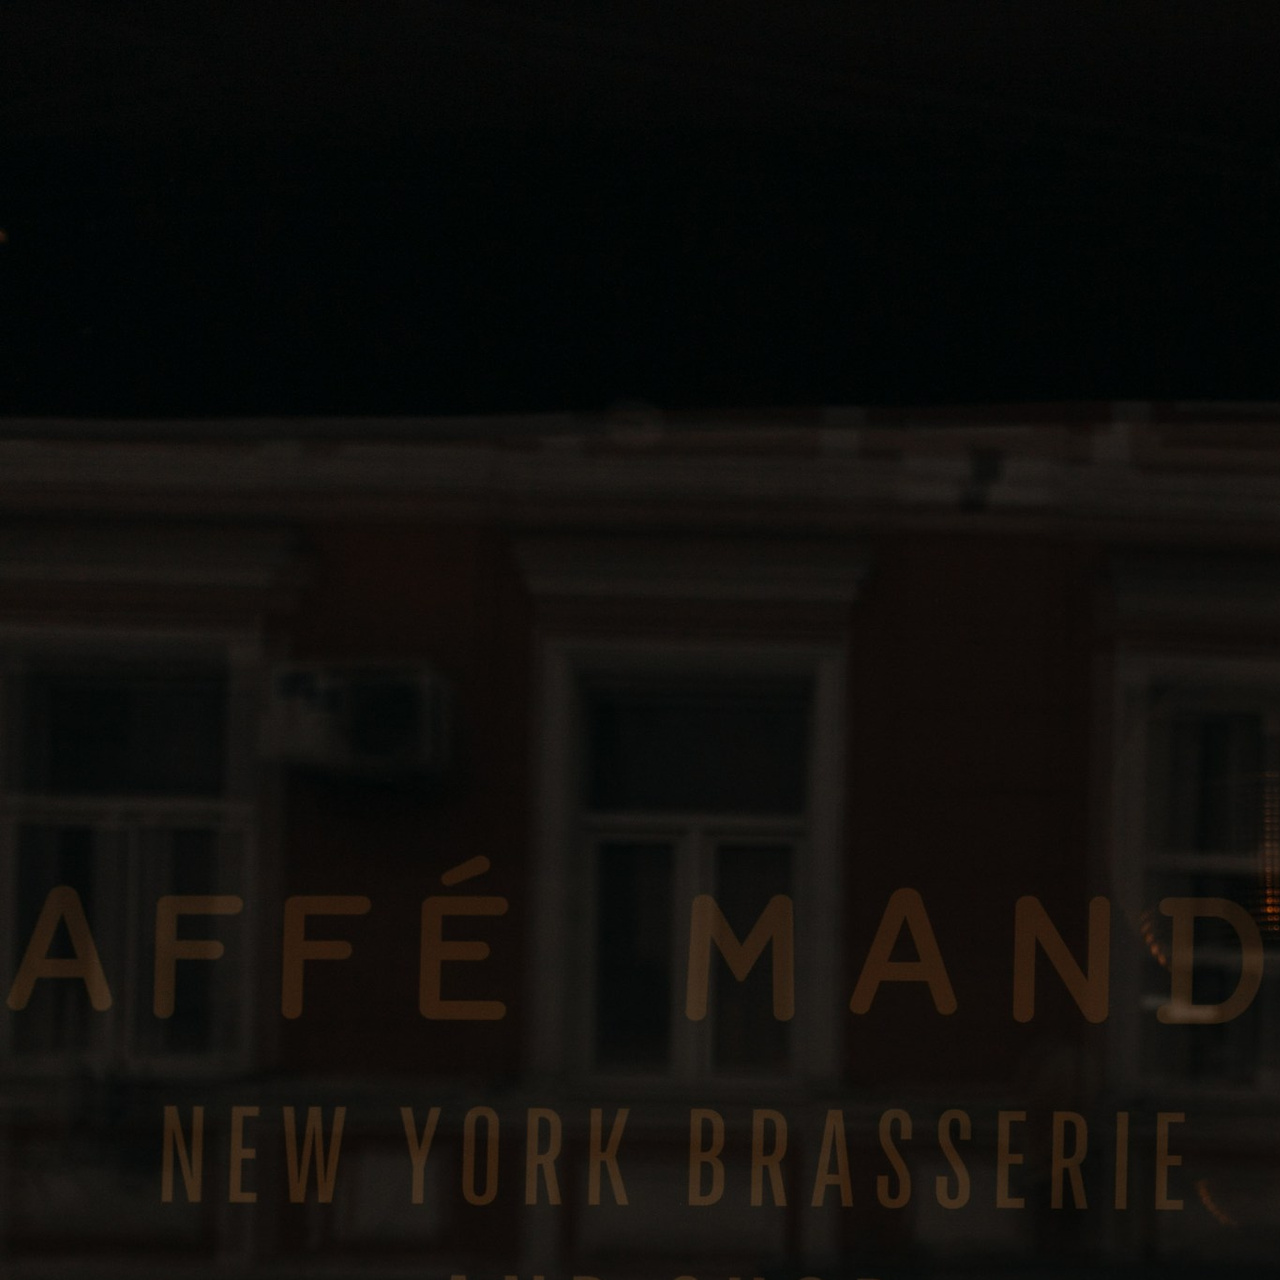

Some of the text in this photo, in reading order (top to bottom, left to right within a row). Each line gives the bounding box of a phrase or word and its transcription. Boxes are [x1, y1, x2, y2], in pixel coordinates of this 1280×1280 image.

[5, 855, 510, 1021] AFFÉ
[160, 1105, 1187, 1211] NEW YORK BRASSERIE
